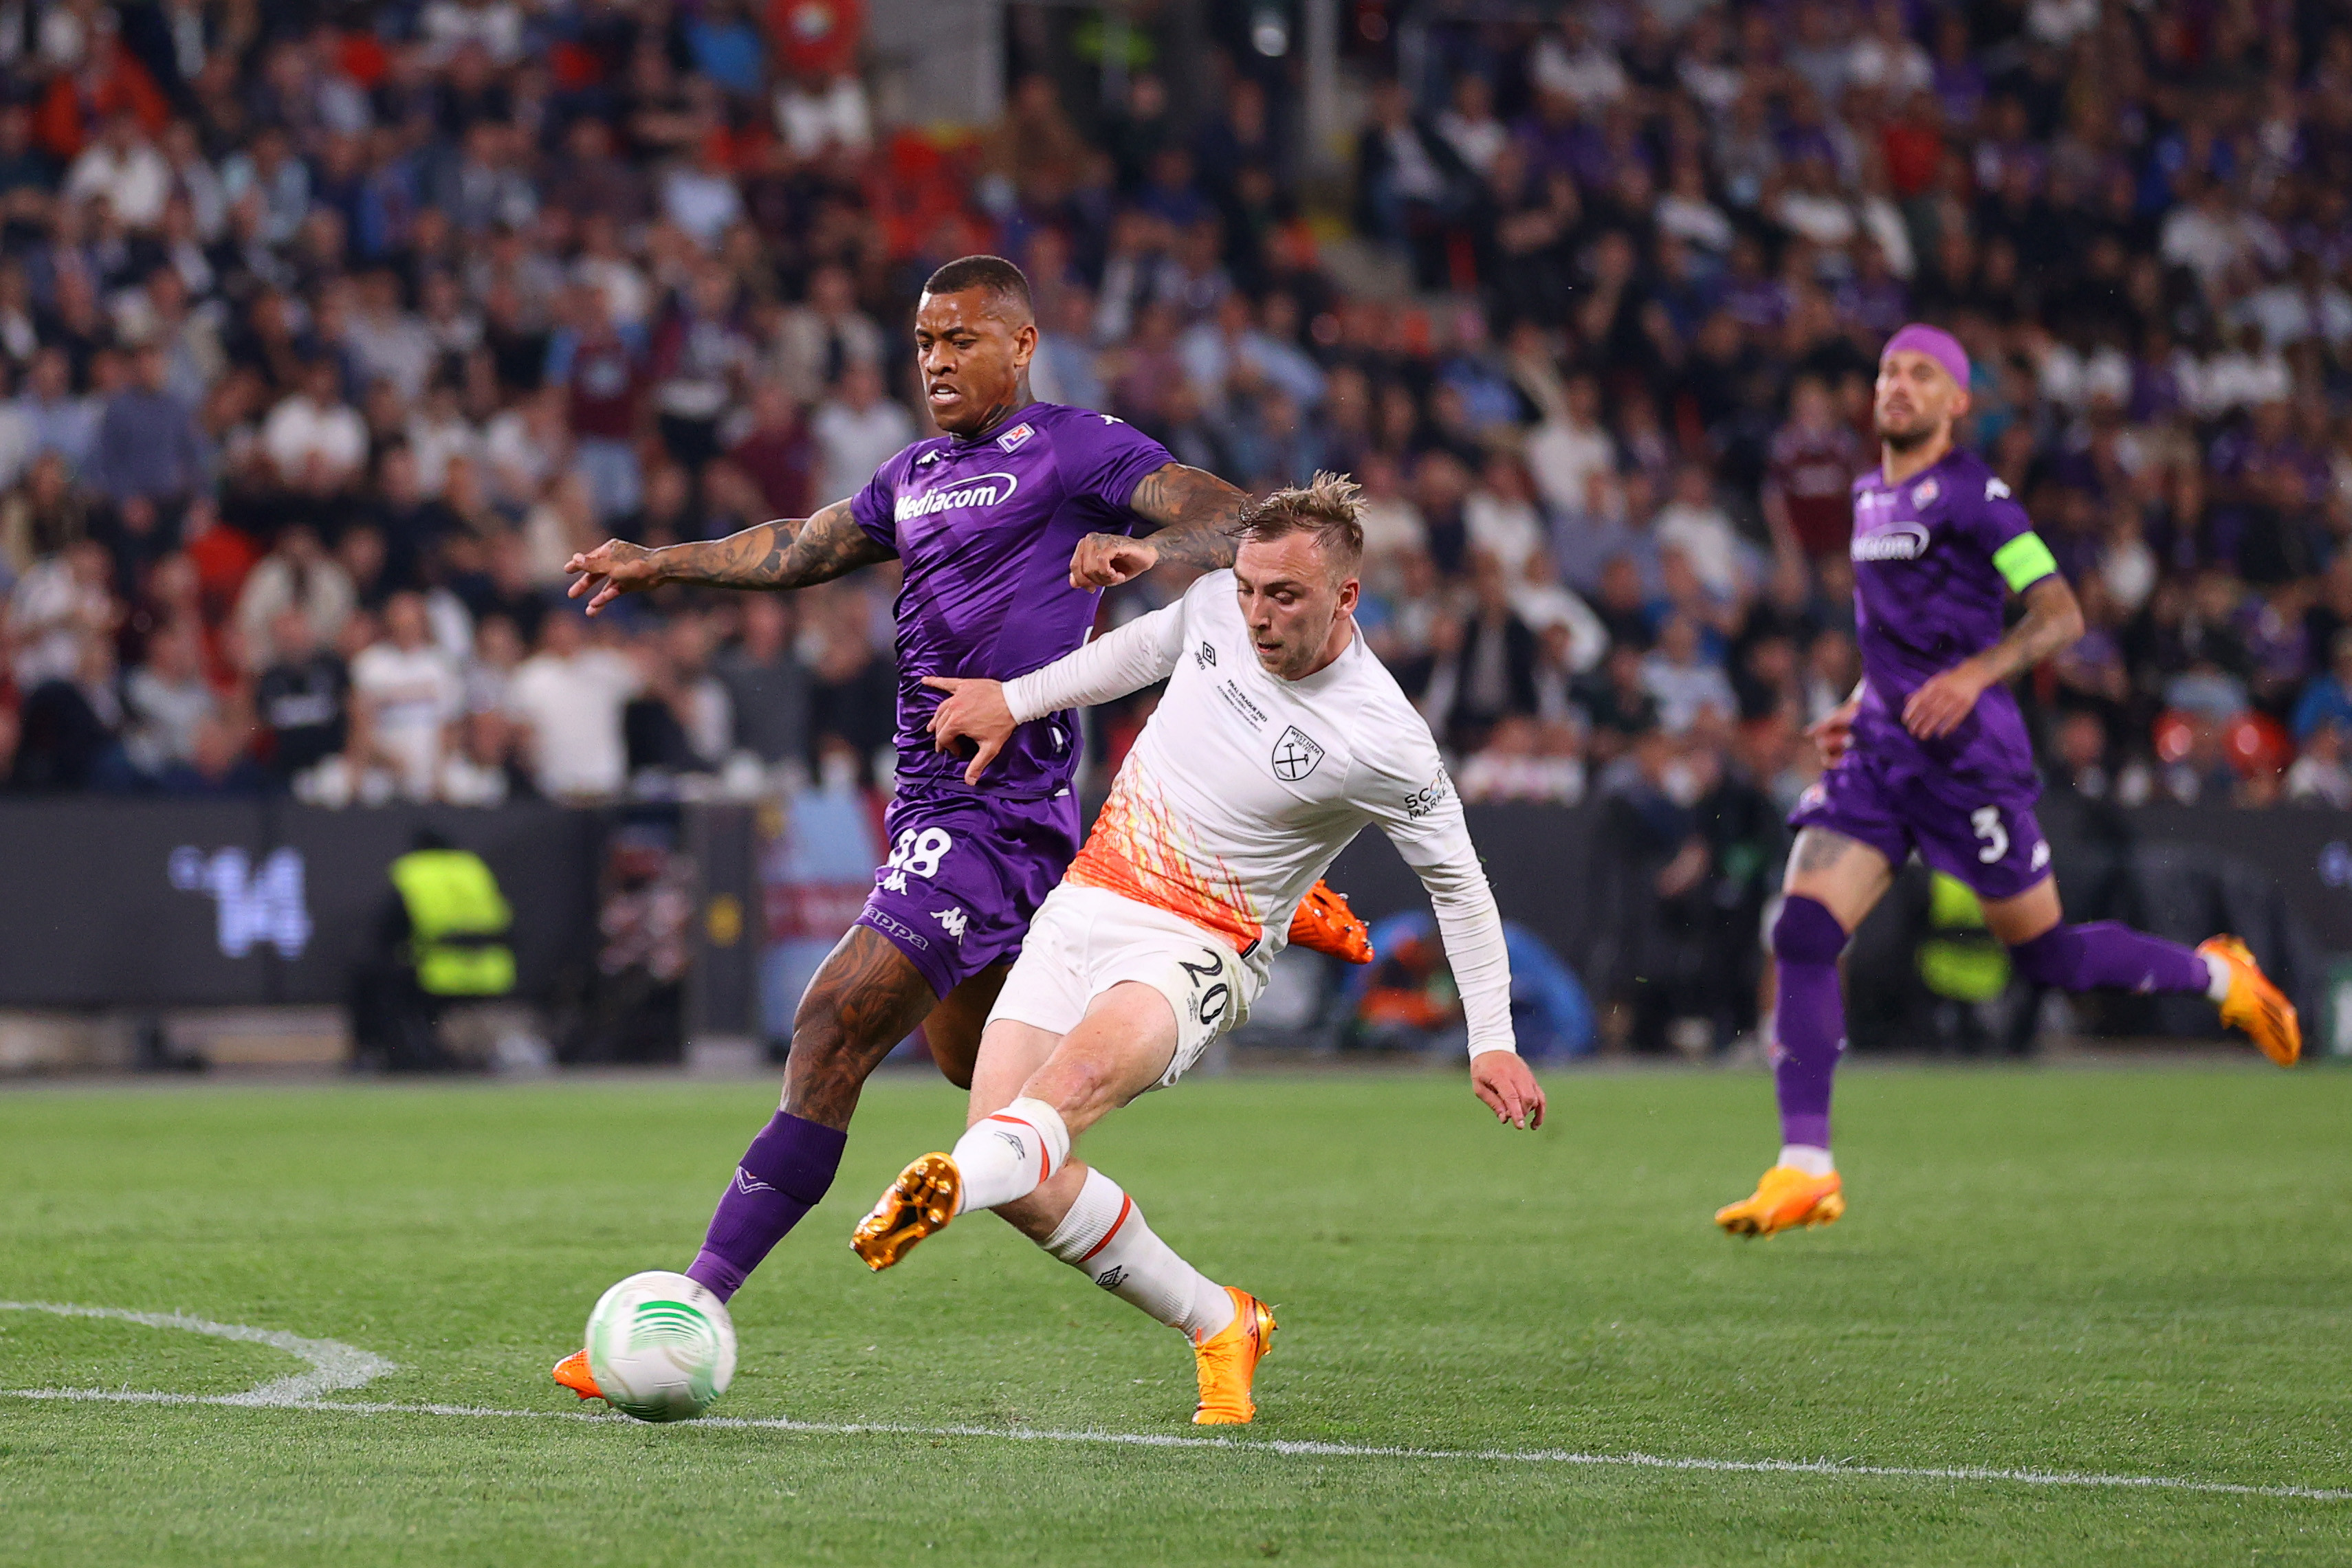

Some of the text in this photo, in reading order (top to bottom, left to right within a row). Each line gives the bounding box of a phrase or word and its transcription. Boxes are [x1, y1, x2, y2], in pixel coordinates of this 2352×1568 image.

[894, 486, 997, 524] Mediacom
[1194, 650, 1205, 670] umbro
[1227, 679, 1239, 694] FINAL
[1239, 692, 1257, 712] PRAGUE
[1291, 729, 1320, 755] WEST HAM
[1294, 738, 1312, 753] UNITED
[1405, 769, 1443, 809] SCOP
[888, 827, 952, 879] 88
[1970, 805, 2009, 864] 3
[865, 907, 928, 951] appa
[1178, 948, 1229, 1025] 20
